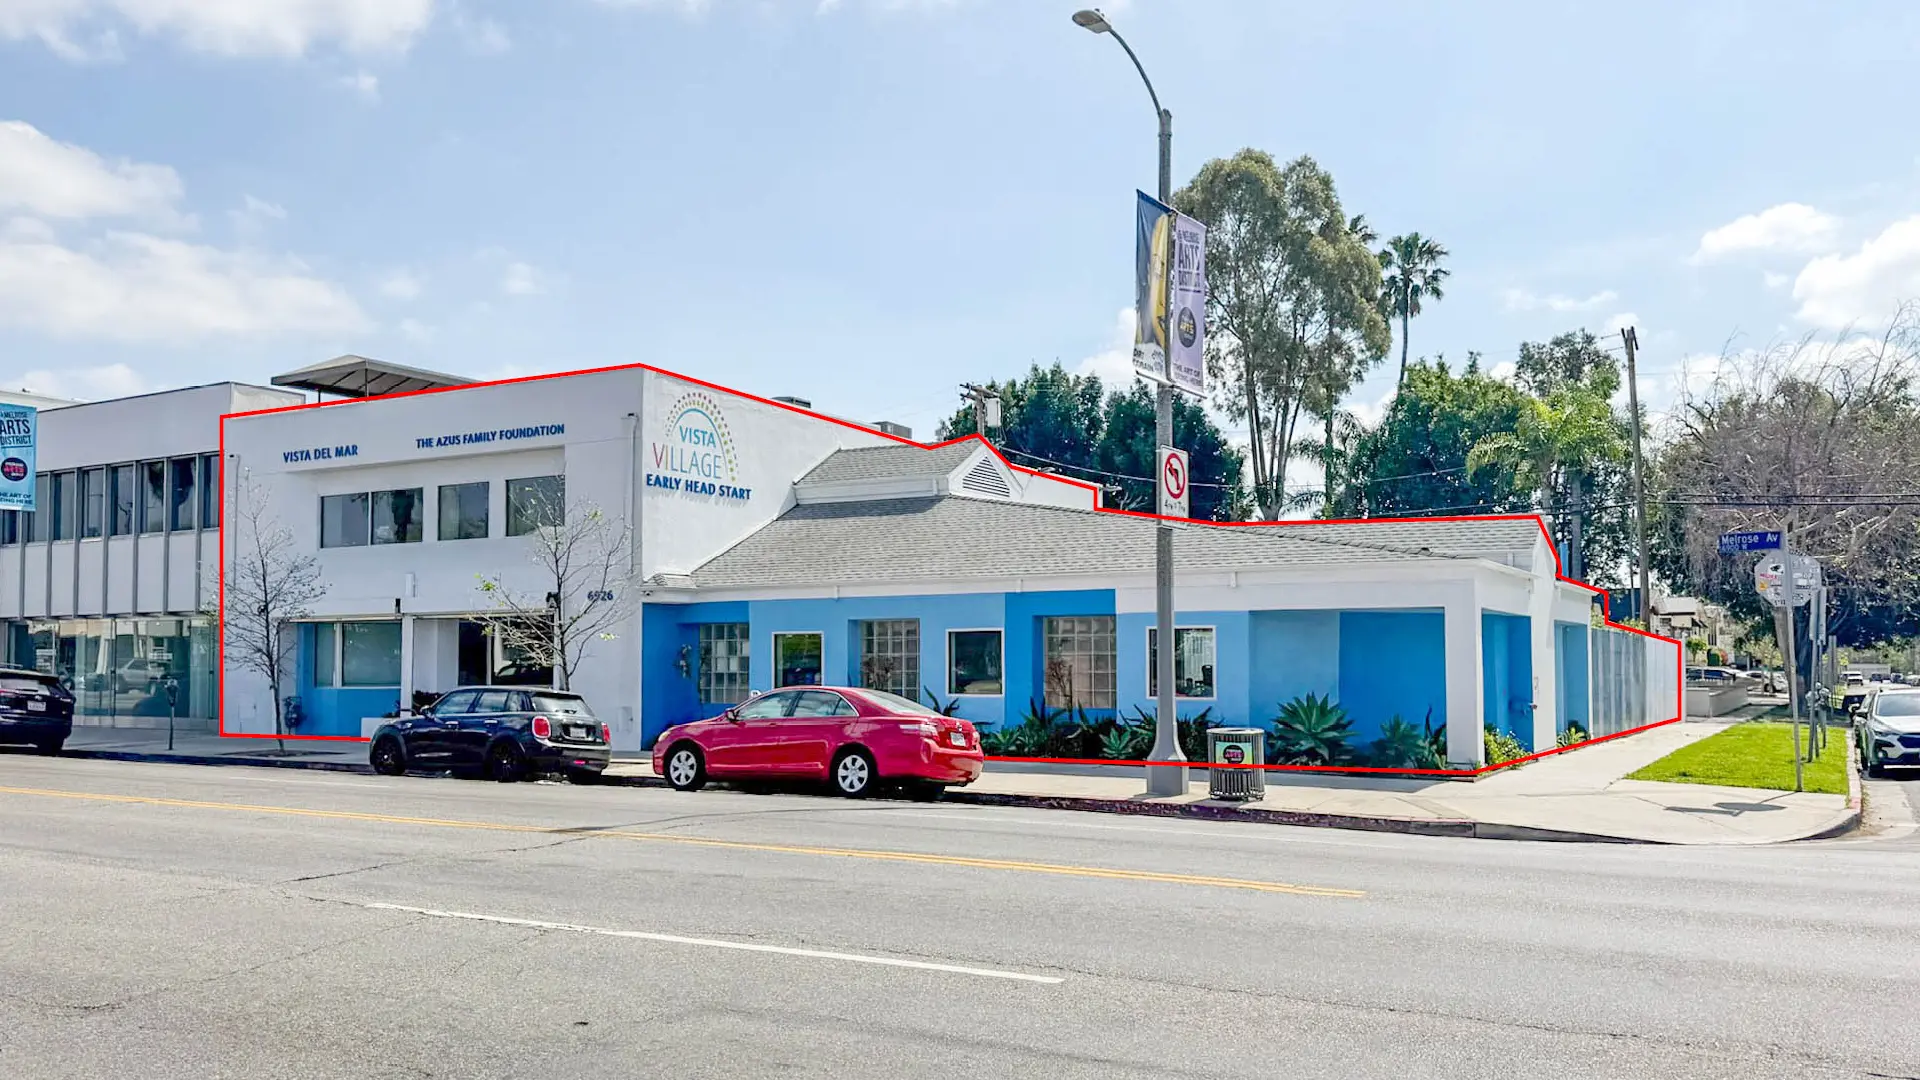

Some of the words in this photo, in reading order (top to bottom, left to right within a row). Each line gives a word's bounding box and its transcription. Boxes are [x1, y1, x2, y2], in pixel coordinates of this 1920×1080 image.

[0, 419, 30, 435] ARTS
[415, 437, 434, 449] THE
[436, 434, 461, 447] AZUS
[462, 430, 497, 444] FAMILY
[499, 423, 565, 440] FOUNDATION
[679, 425, 717, 448] VISTA
[283, 449, 311, 463] VISTA
[314, 447, 332, 460] DEL
[334, 444, 358, 458] MAR
[652, 442, 723, 480] VILLAGE
[646, 473, 682, 490] EARLY
[685, 479, 716, 496] HEAD
[719, 485, 752, 500] START
[1721, 533, 1760, 545] Melrose
[1766, 532, 1778, 543] Av
[587, 590, 614, 601] 6926
